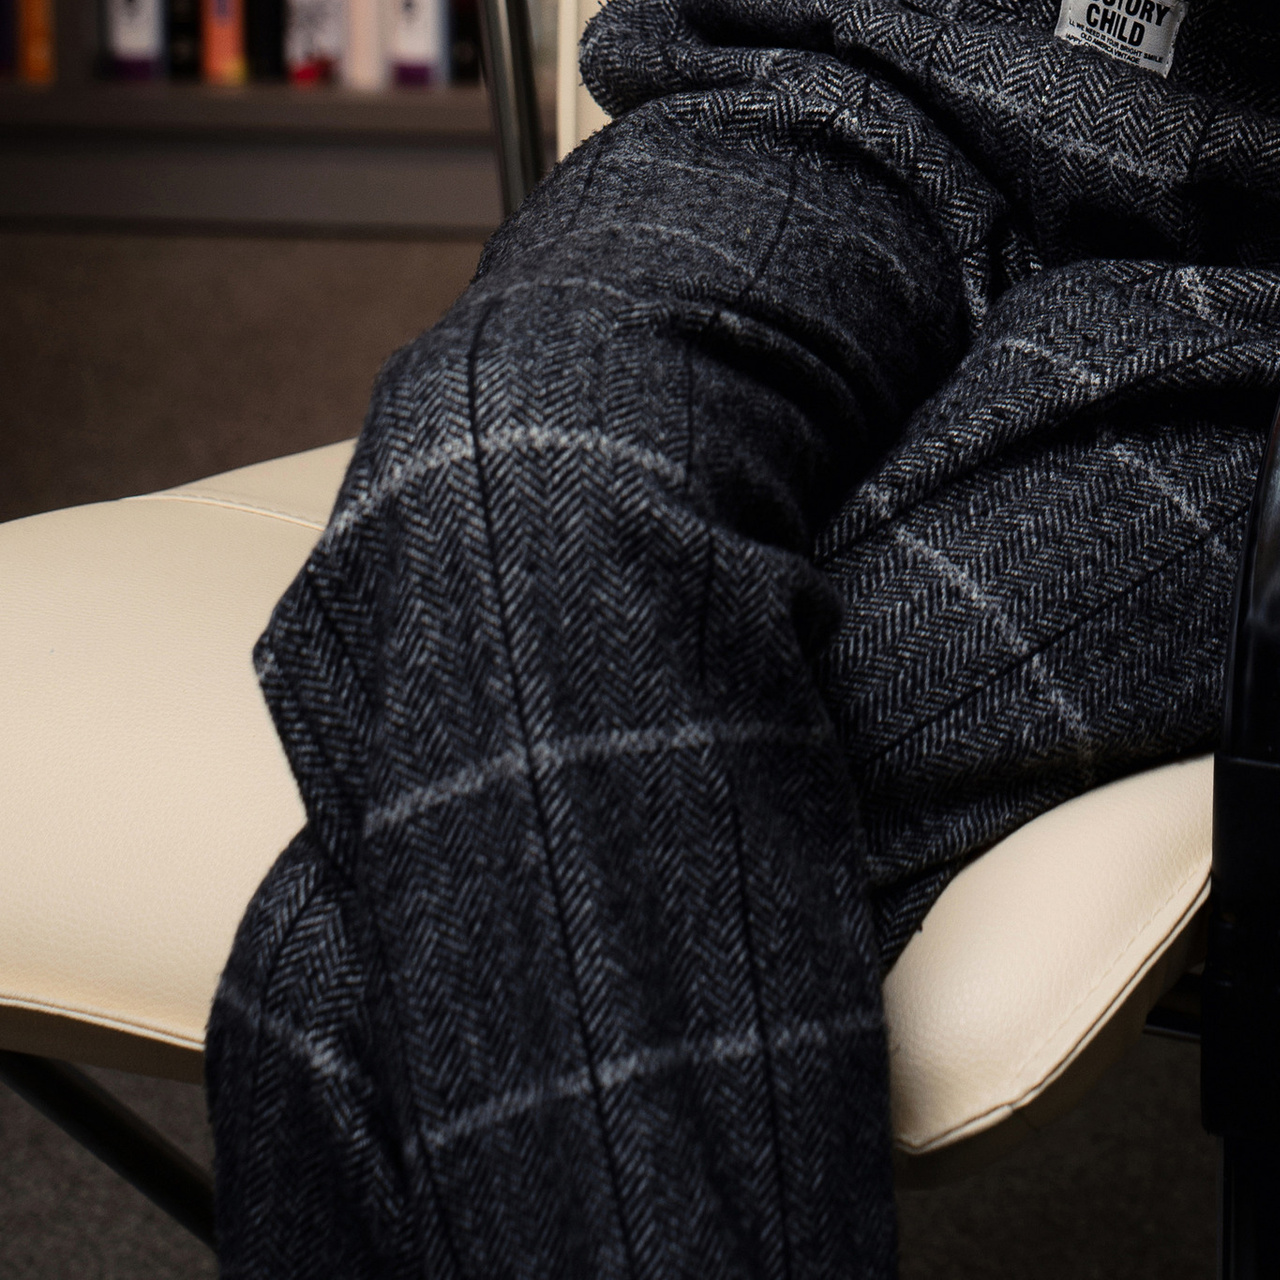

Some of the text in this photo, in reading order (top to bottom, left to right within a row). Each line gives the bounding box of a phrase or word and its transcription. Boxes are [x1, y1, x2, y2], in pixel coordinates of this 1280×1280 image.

[1086, 3, 1146, 47] CHILD
[1080, 32, 1093, 42] OLD
[1092, 38, 1115, 55] AMERICA
[1113, 48, 1141, 64] VINTAGE
[1085, 26, 1101, 38] NEED
[1106, 37, 1120, 49] YOUR
[1119, 43, 1143, 57] BRIGHT
[1143, 52, 1164, 64] SMILE
